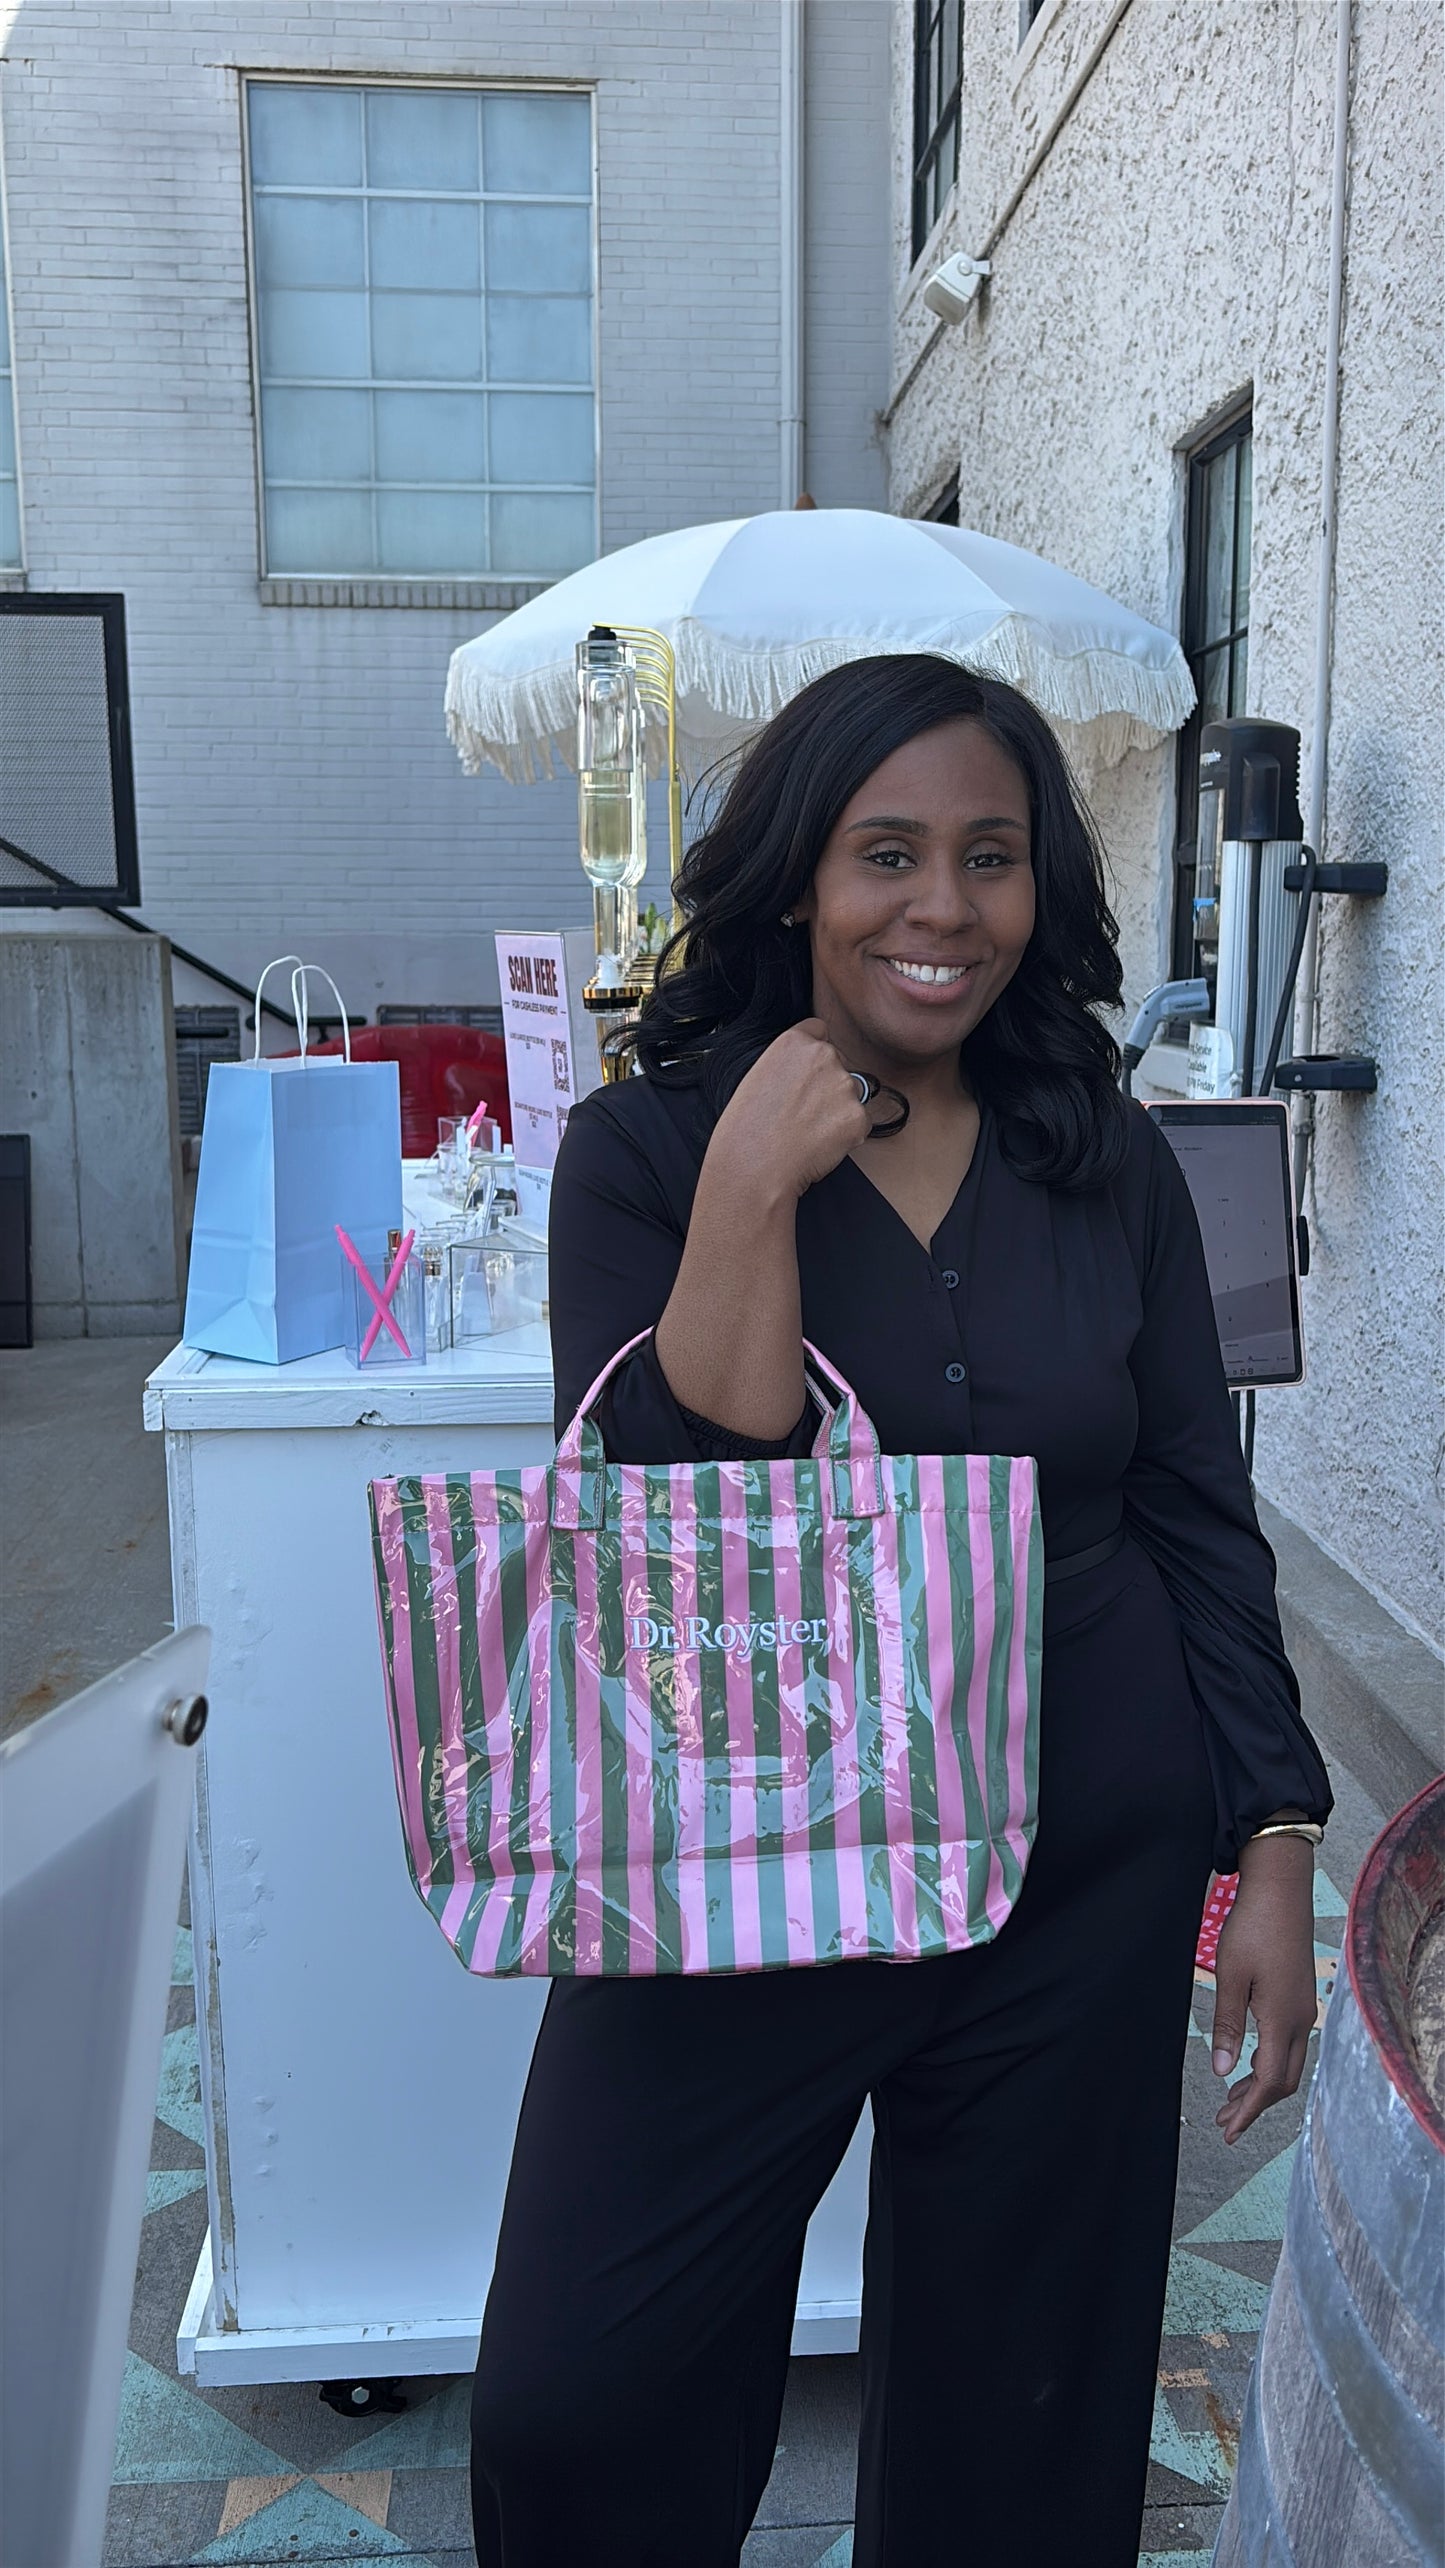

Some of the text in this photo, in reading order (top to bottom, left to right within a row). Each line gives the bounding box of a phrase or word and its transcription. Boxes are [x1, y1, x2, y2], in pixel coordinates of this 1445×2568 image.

[508, 955, 559, 997] SCAN HERE
[1197, 1078, 1216, 1095] Friday
[630, 1615, 827, 1657] Dr. Royster
